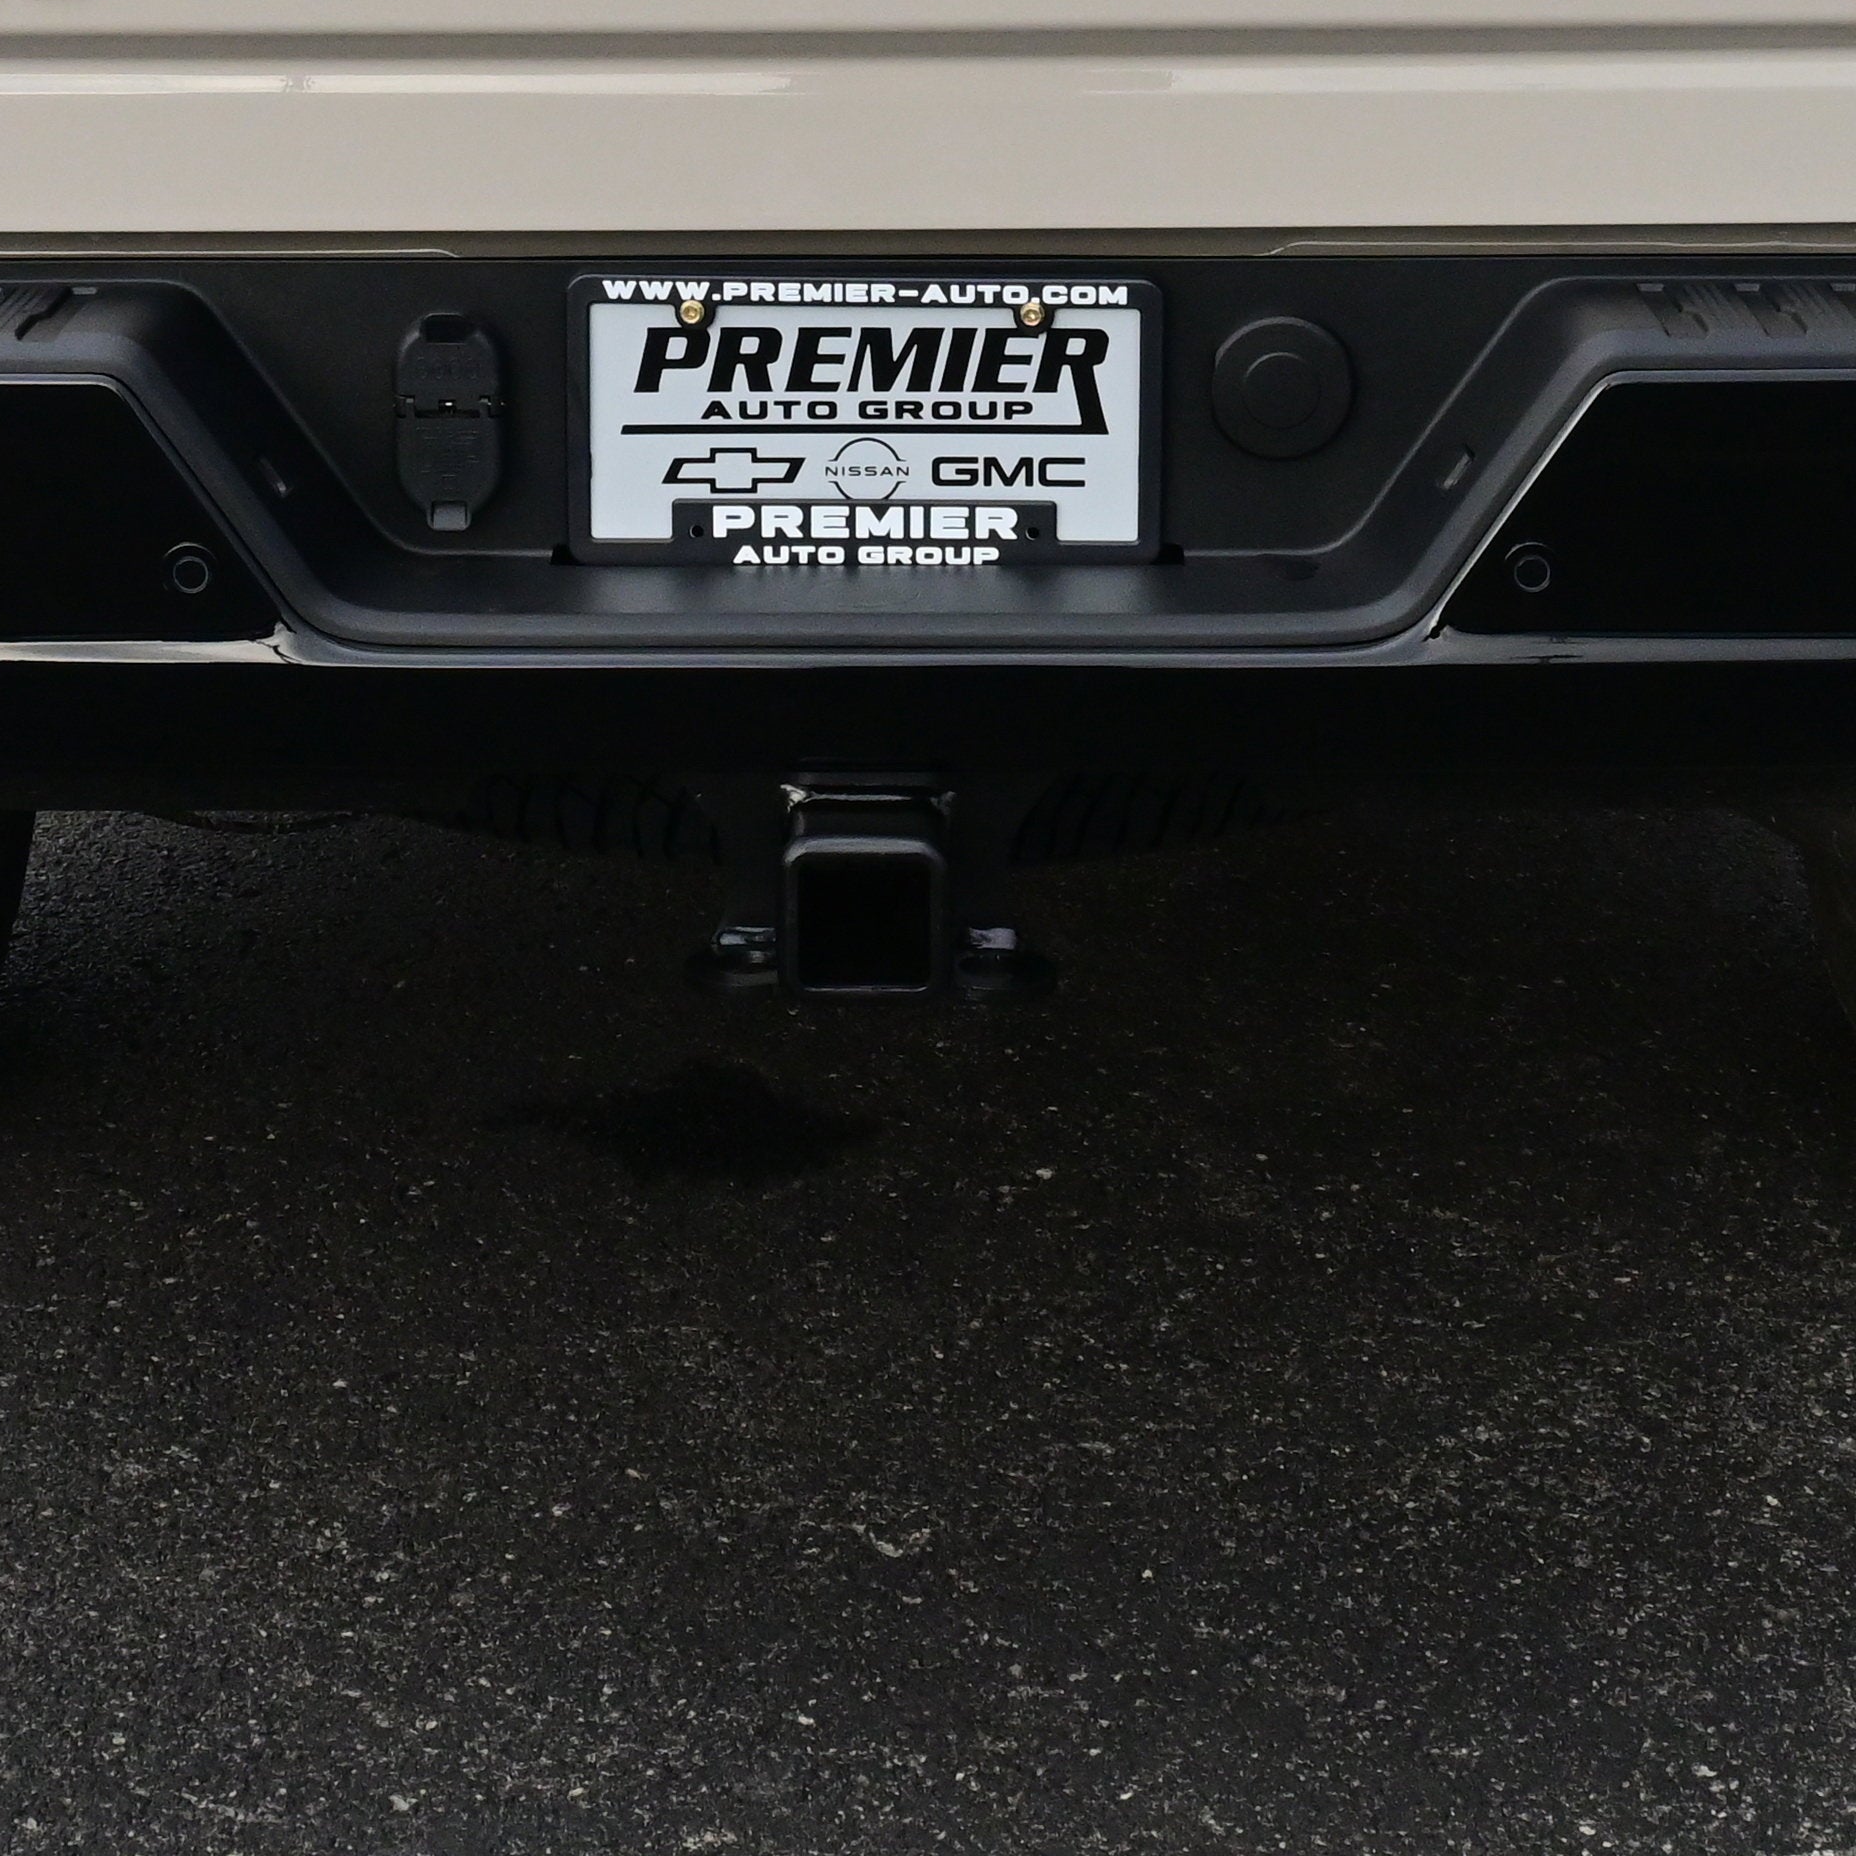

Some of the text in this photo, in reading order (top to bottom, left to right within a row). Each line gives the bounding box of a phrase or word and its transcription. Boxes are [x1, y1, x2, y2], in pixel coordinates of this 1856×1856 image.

[601, 278, 1129, 307] WWW.PREMIER-AUTO.COM
[633, 326, 1110, 435] PREMIER
[700, 400, 1034, 421] AUTO GROUP
[824, 456, 1086, 488] NISSAN GMC
[712, 505, 1020, 539] PREMIER
[733, 545, 1001, 566] AUTO GROUP
